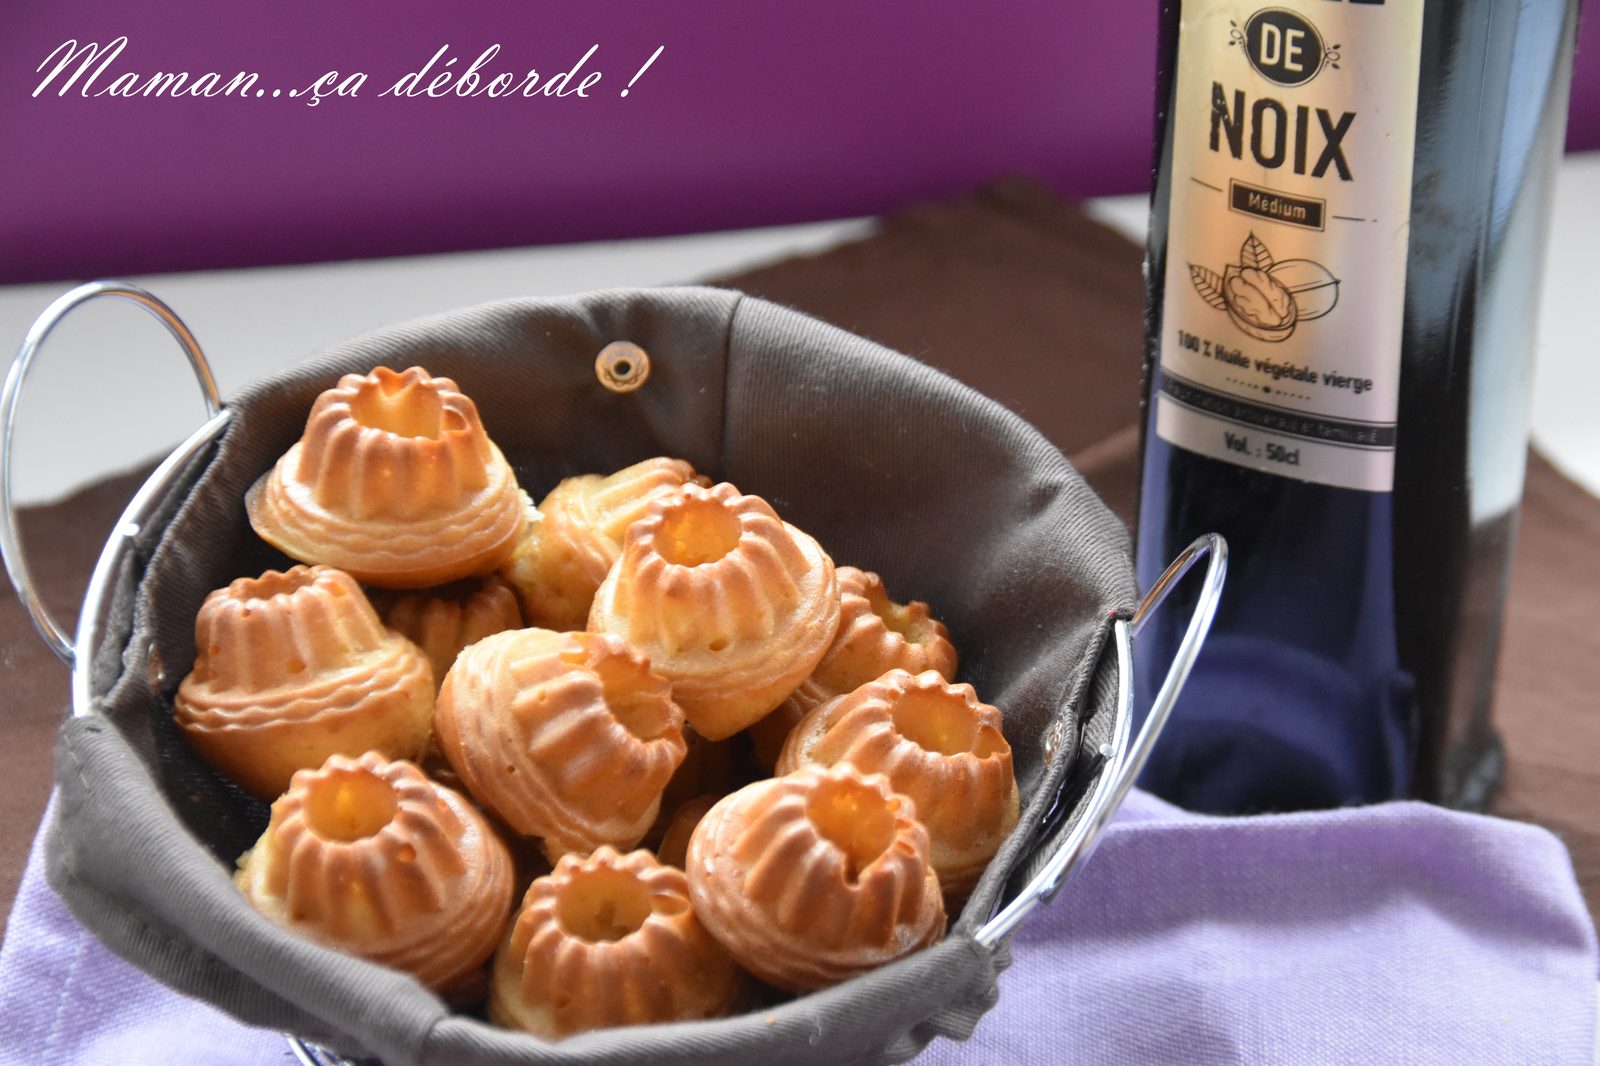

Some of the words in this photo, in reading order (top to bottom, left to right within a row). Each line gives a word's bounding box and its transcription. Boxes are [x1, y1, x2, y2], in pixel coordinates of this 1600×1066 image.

[1260, 22, 1305, 71] DE
[1209, 81, 1357, 182] NOIX
[1248, 192, 1306, 220] Médium
[1215, 344, 1250, 369] Huile
[1254, 357, 1318, 384] végétale
[1323, 370, 1373, 395] vierge
